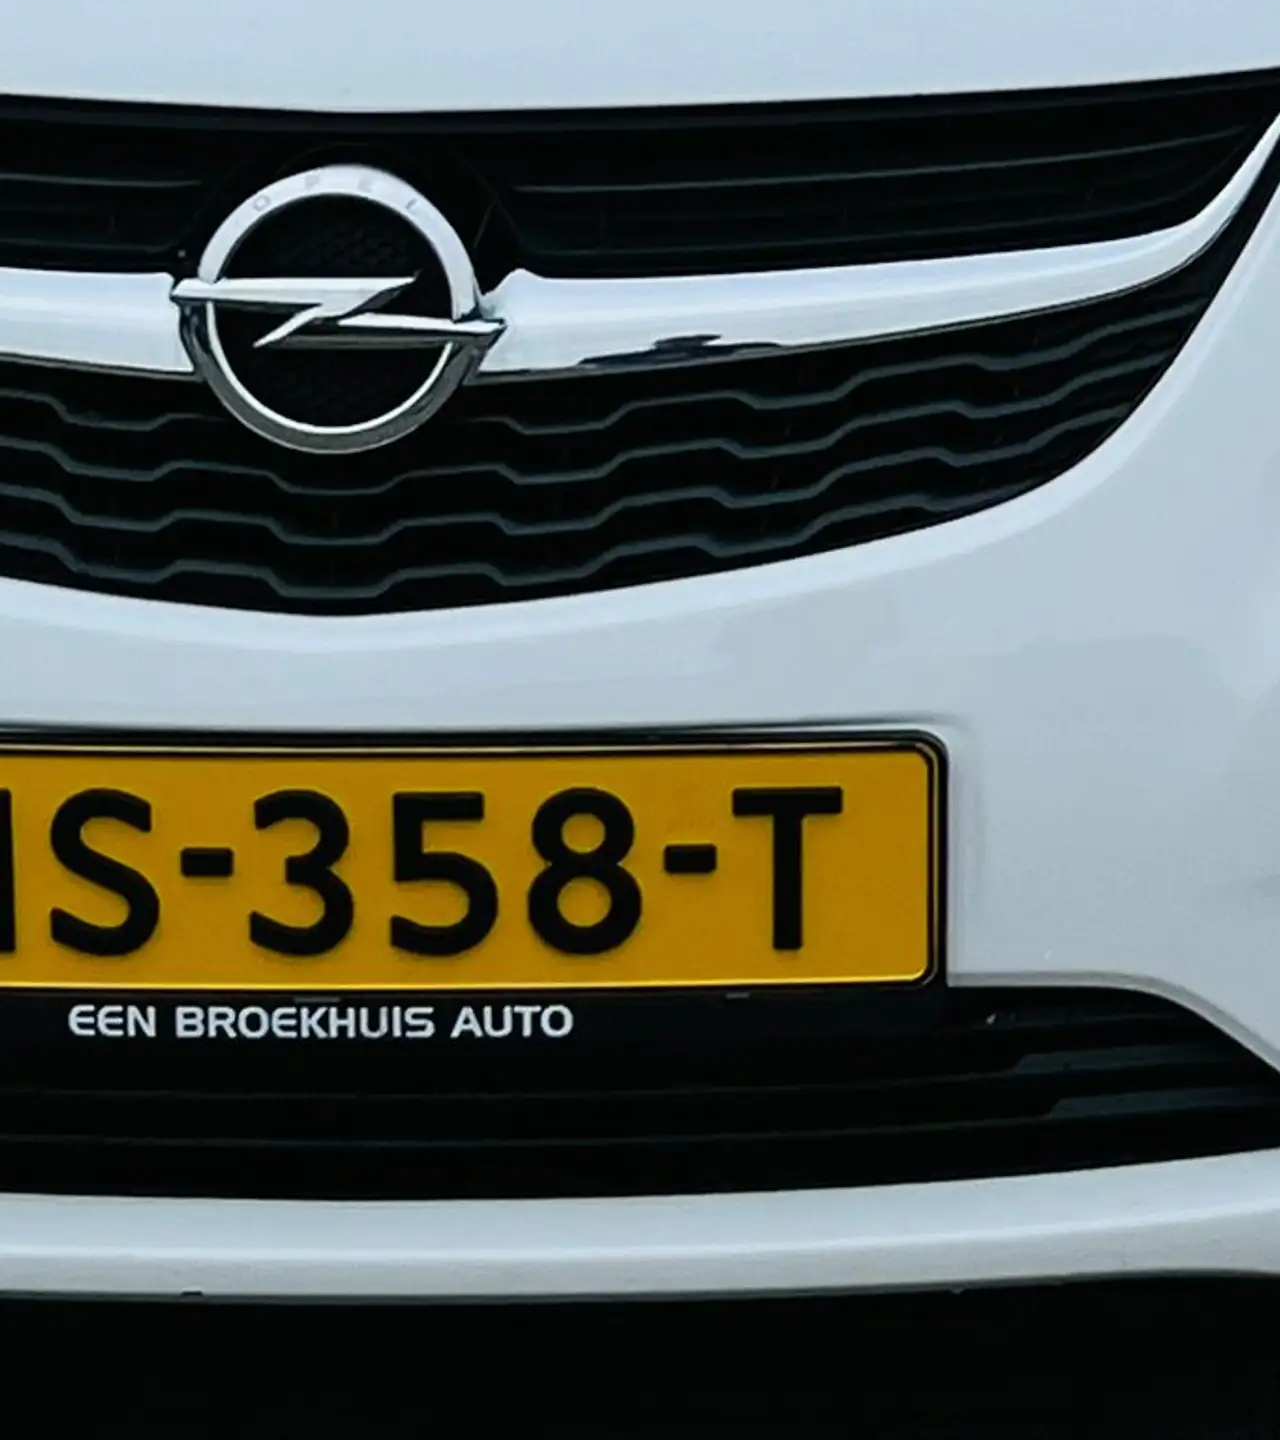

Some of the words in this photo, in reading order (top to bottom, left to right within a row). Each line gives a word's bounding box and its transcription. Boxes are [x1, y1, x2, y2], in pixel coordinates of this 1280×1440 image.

[0, 786, 843, 957] S-358-T
[68, 1004, 157, 1037] EEN
[175, 1005, 435, 1038] BROEKHUIS
[450, 1004, 573, 1037] AUTO
